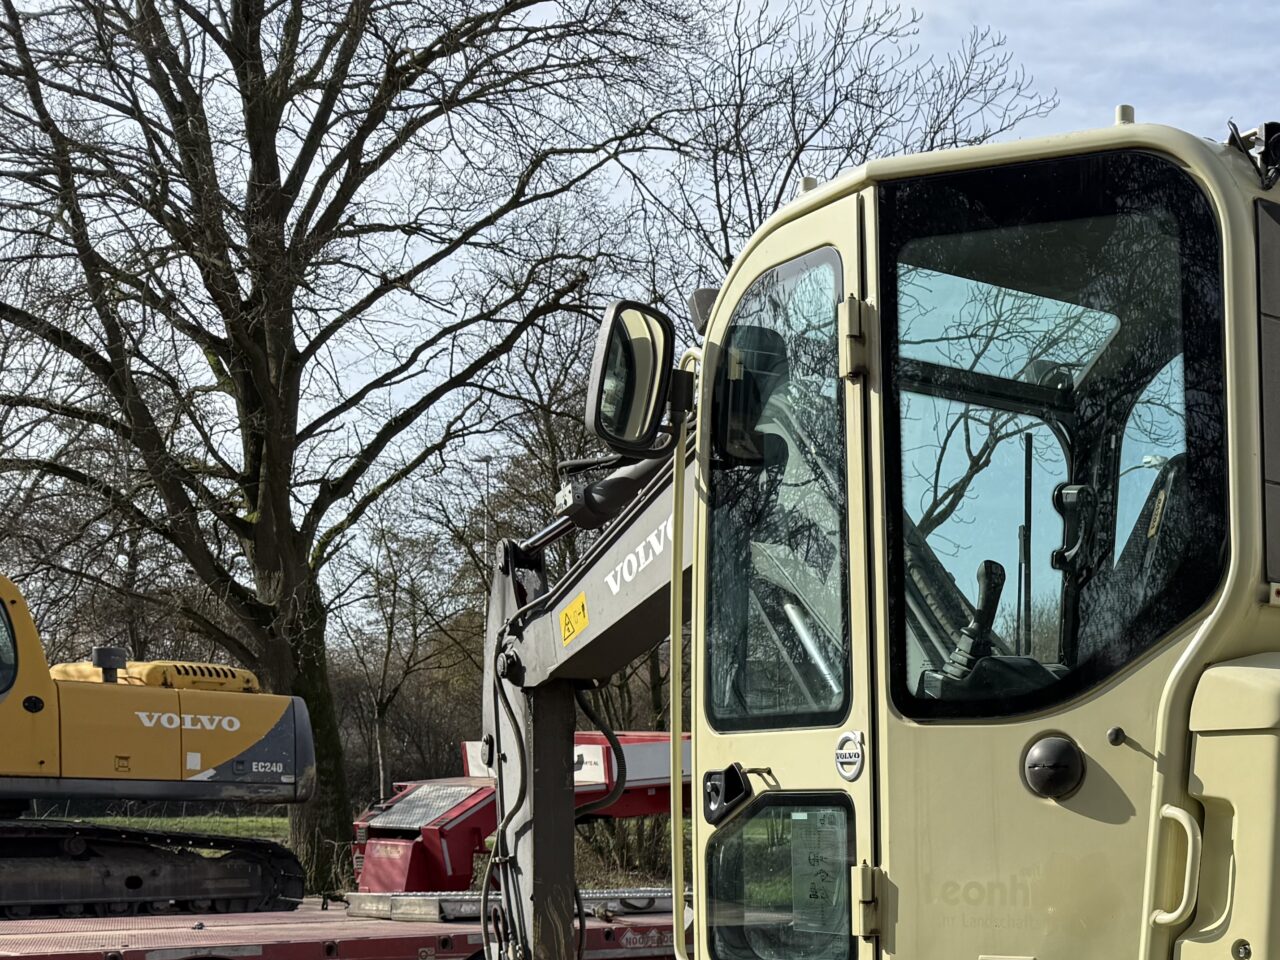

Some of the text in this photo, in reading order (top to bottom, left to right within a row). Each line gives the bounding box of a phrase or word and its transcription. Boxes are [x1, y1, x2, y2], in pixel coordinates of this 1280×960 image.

[134, 711, 241, 732] VOLVO
[835, 752, 861, 760] VOLVO
[252, 762, 283, 773] EC240
